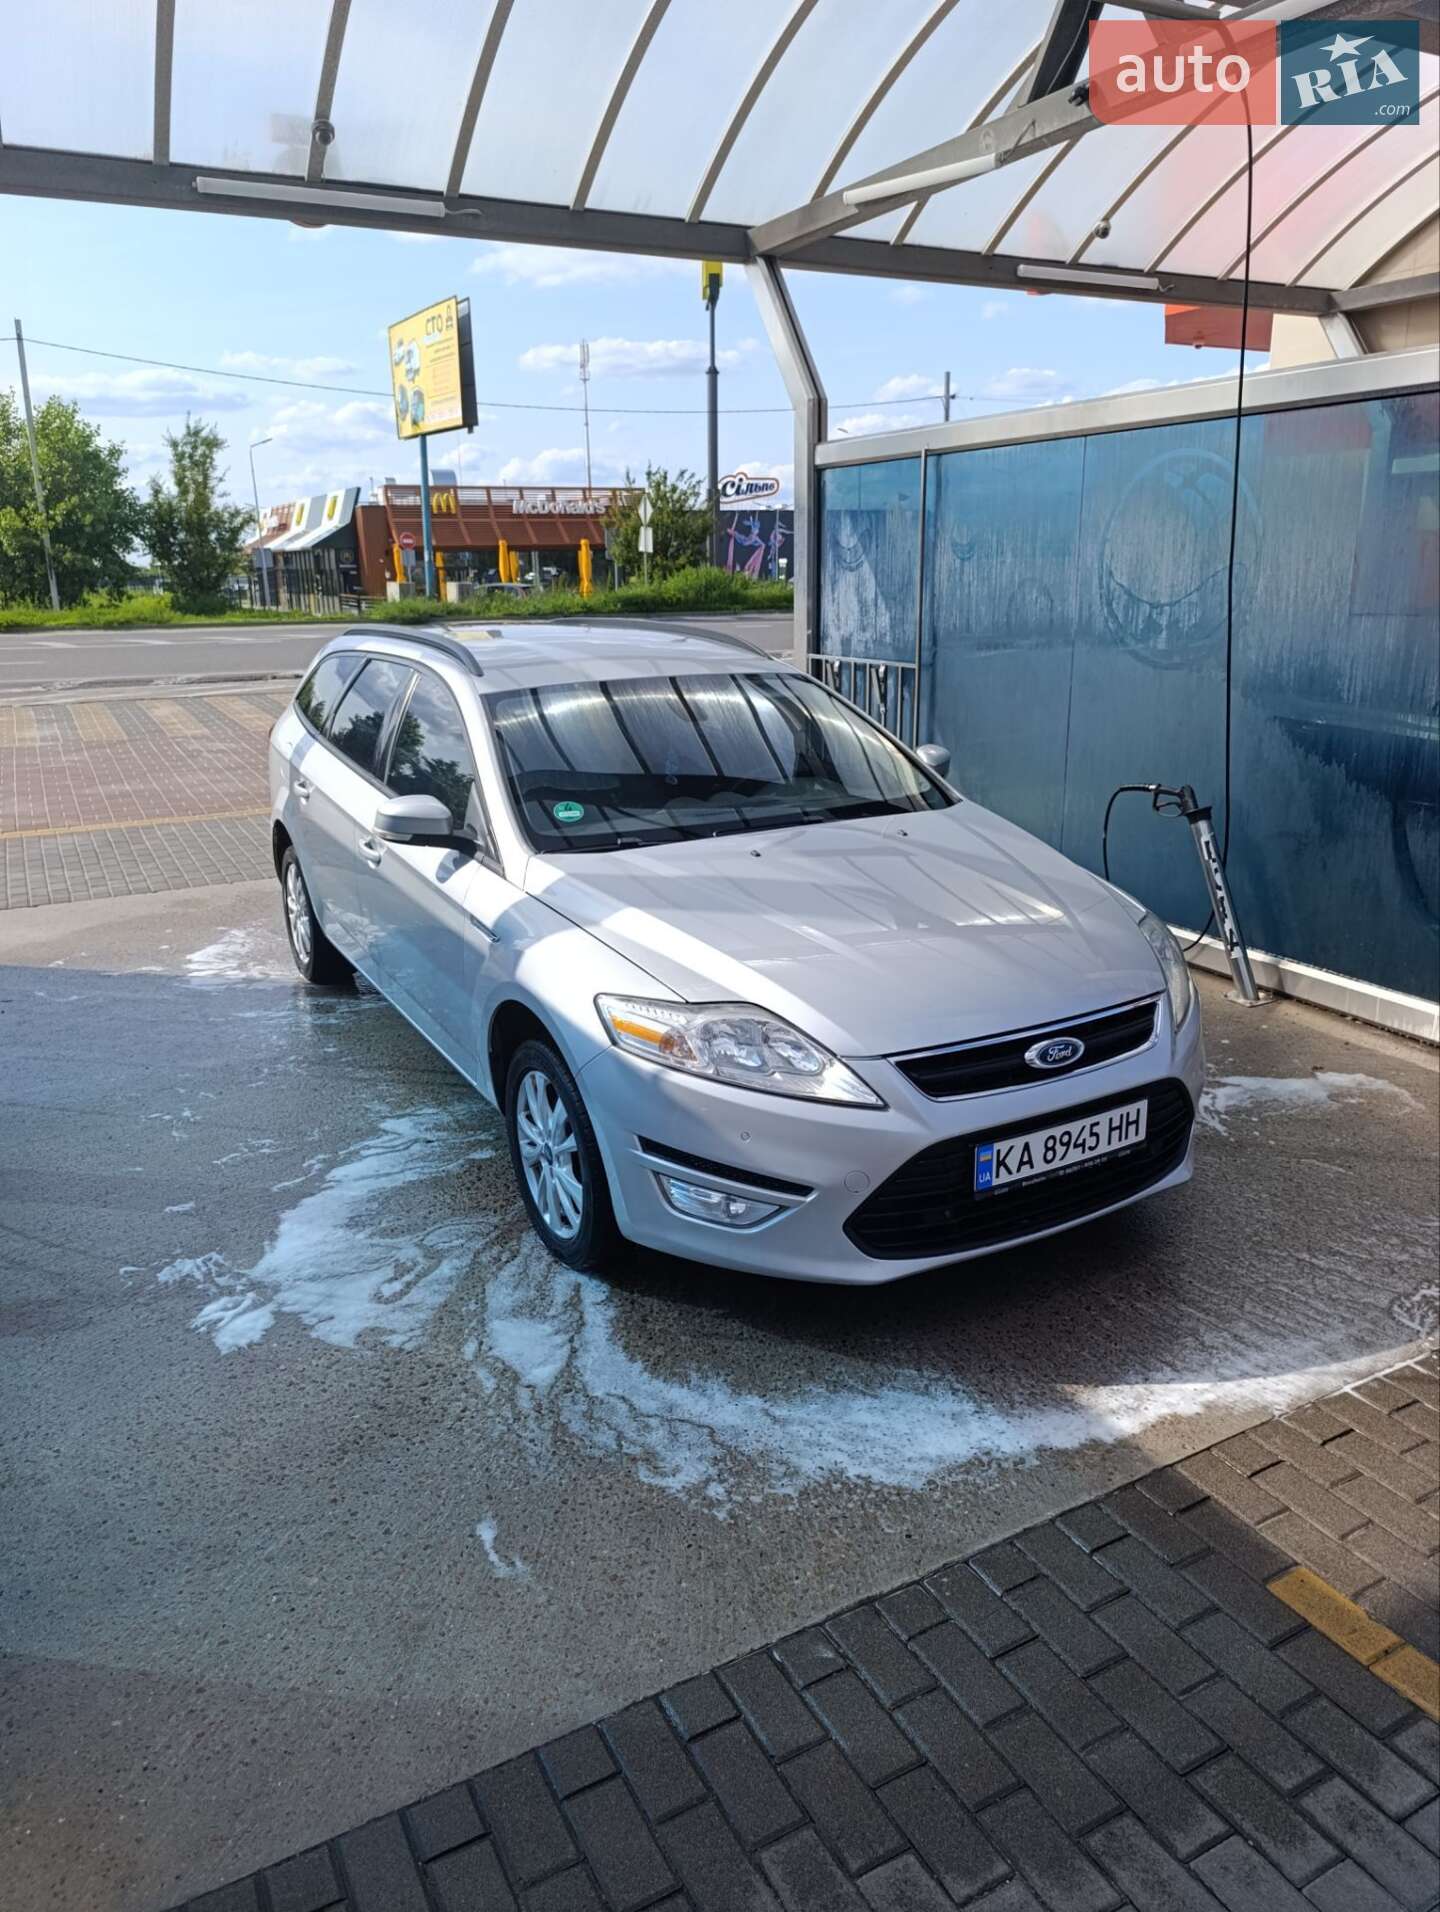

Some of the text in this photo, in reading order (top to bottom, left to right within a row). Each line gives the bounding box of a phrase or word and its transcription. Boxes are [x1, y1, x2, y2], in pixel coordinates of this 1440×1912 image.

[512, 499, 605, 514] McDonald's
[1047, 1044, 1072, 1061] Ford
[995, 1142, 1034, 1178] KA
[1043, 1121, 1099, 1164] 8945
[1108, 1108, 1140, 1146] HH
[979, 1172, 991, 1183] UA
